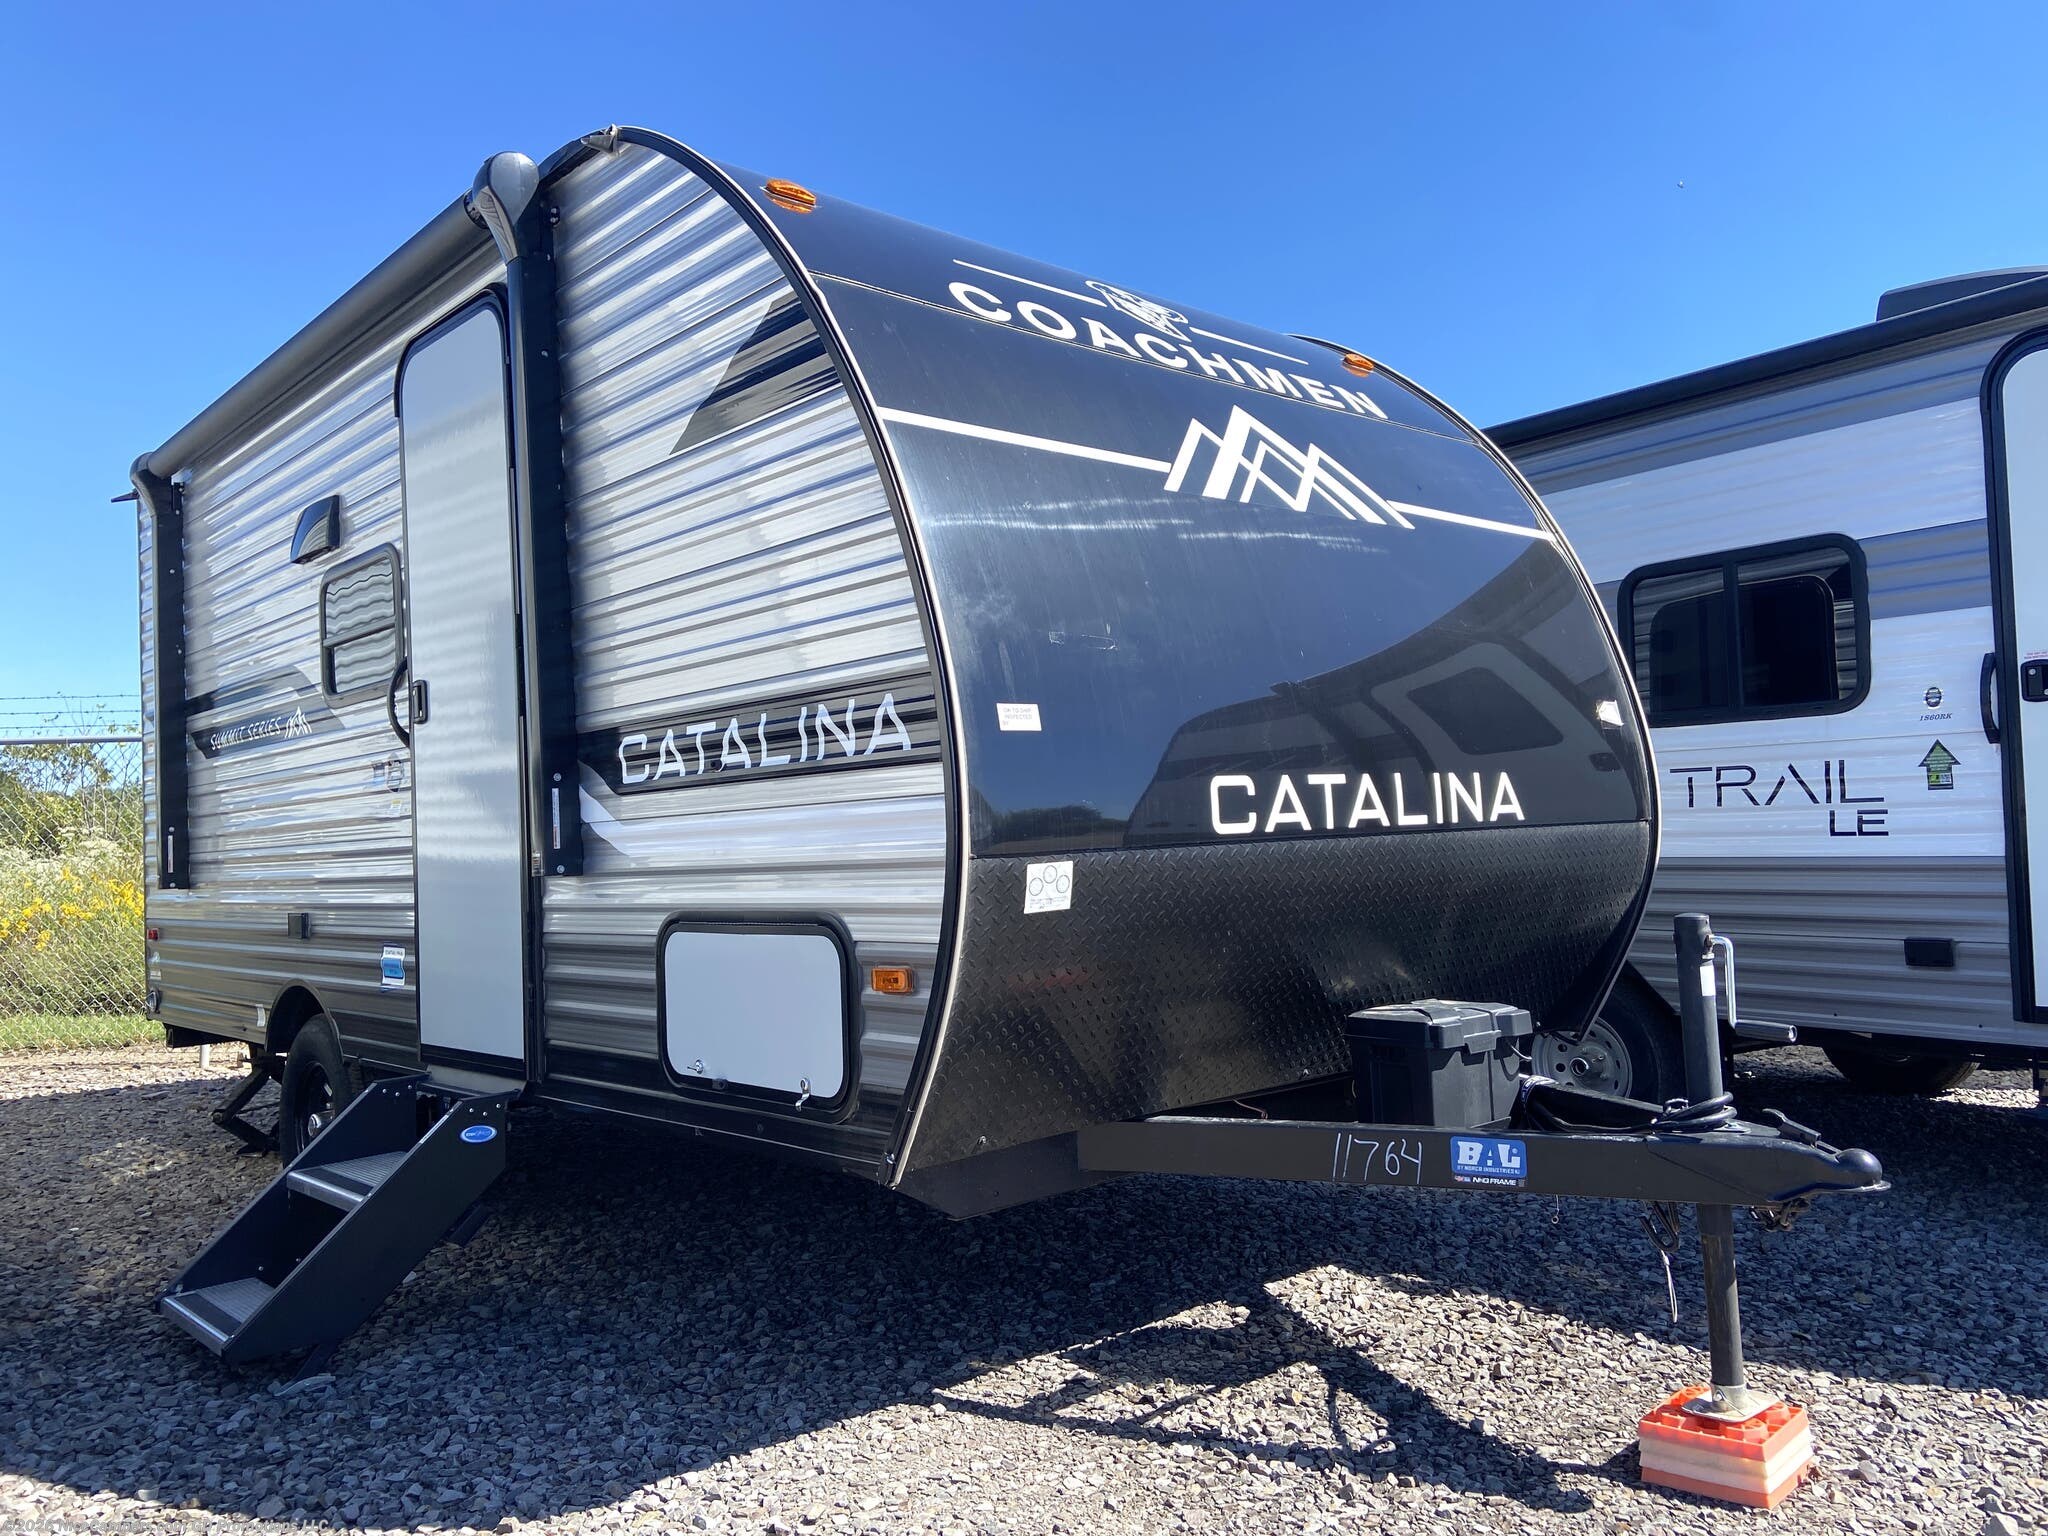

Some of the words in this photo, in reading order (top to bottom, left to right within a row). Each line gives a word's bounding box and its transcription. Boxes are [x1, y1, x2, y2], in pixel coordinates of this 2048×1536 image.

[948, 281, 1389, 419] COACHMEN
[210, 726, 245, 751] SUMMIT
[248, 716, 282, 740] SERIES
[617, 692, 912, 785] CATALINA
[1210, 771, 1526, 836] CATALINA
[1669, 760, 1885, 808] TRAIL
[1829, 809, 1889, 837] LE
[1331, 1132, 1423, 1185] 11764
[1457, 1141, 1521, 1168] BAL
[1490, 1178, 1517, 1186] FRAME
